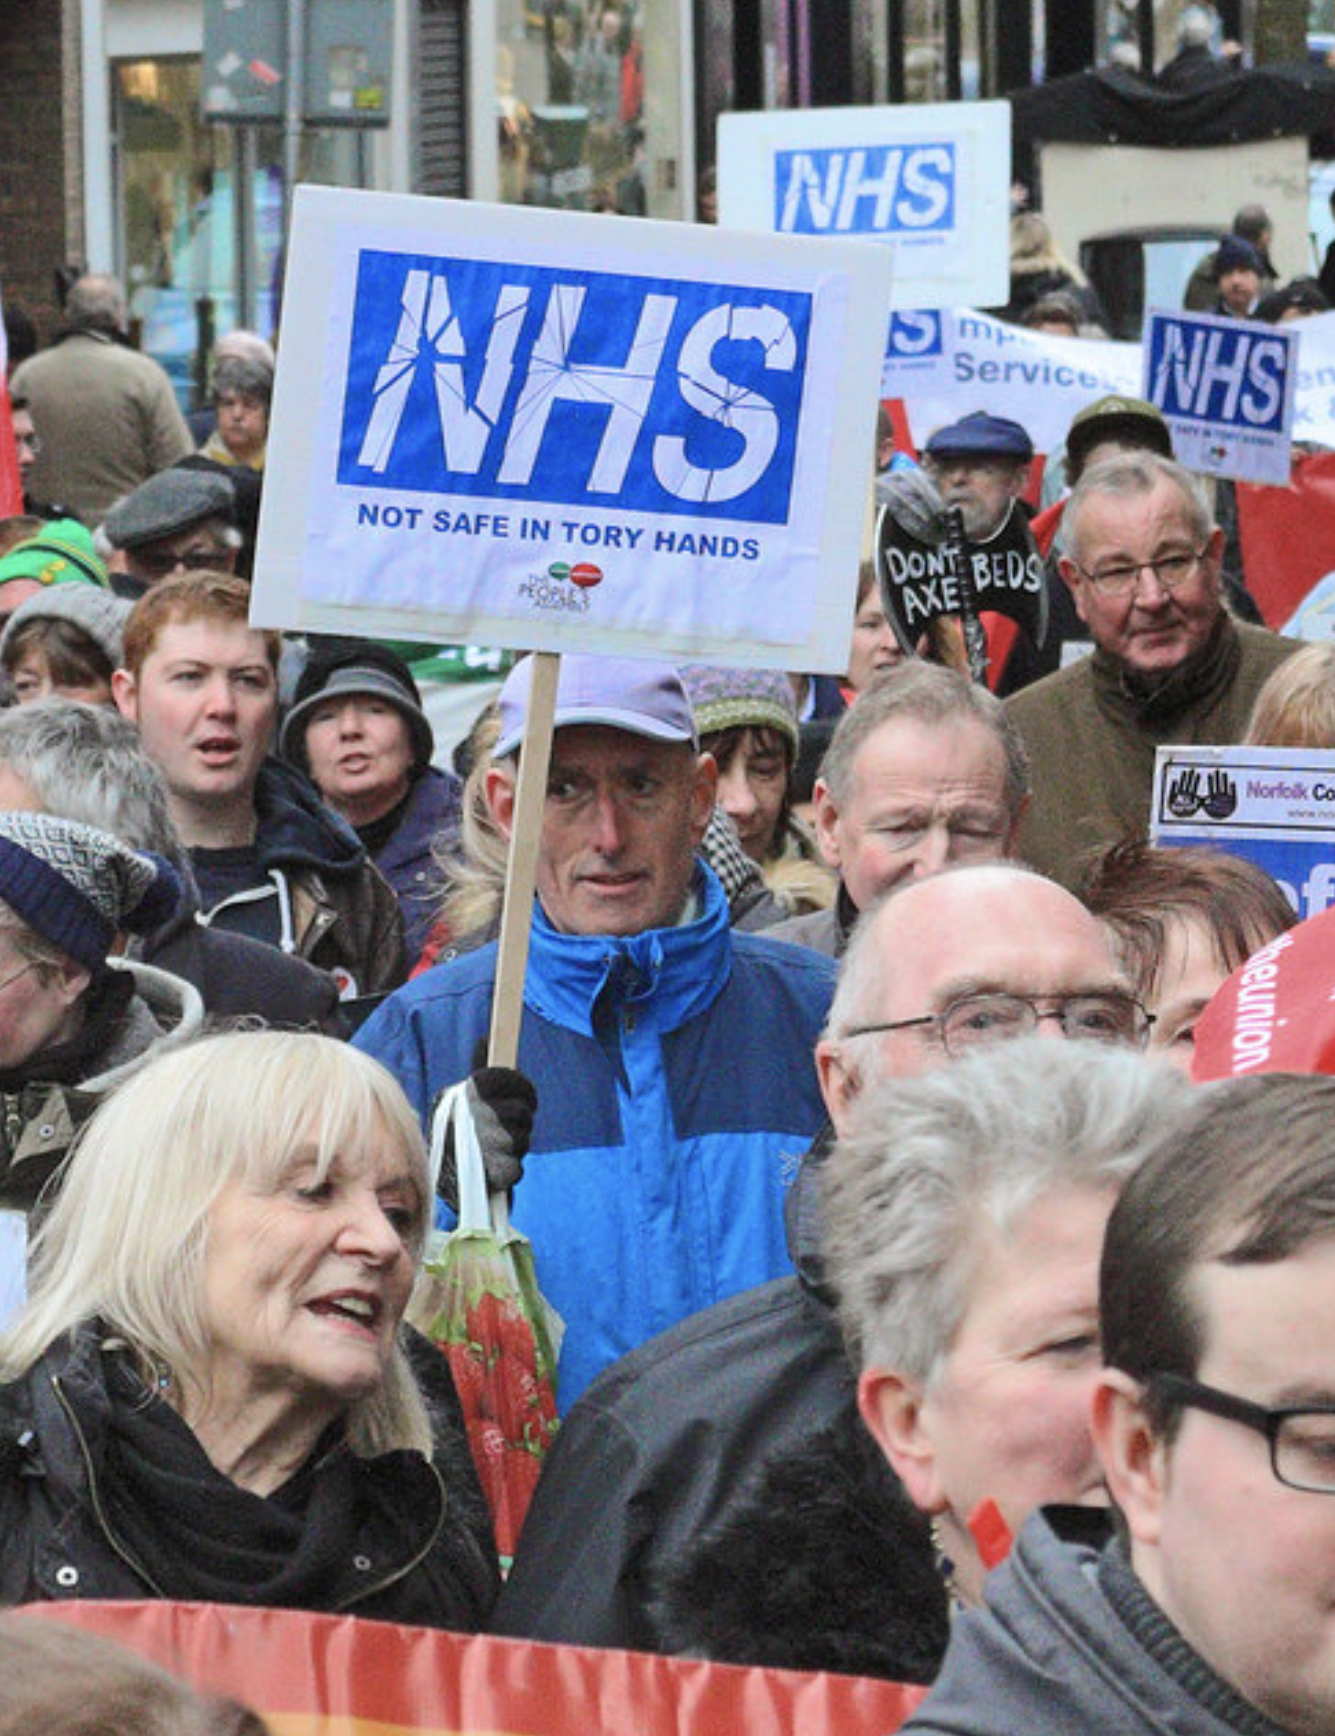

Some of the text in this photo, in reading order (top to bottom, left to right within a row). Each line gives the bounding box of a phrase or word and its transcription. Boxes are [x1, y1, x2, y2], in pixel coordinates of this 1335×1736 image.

[780, 148, 953, 231] NHS
[357, 269, 798, 502] NHS
[1152, 323, 1285, 425] NHS
[357, 503, 761, 560] NOT SAFE IN TORY HANDS
[885, 544, 960, 585] DONT
[970, 550, 1044, 593] BEDS
[901, 577, 961, 625] AXE
[1246, 780, 1308, 800] Norfolk
